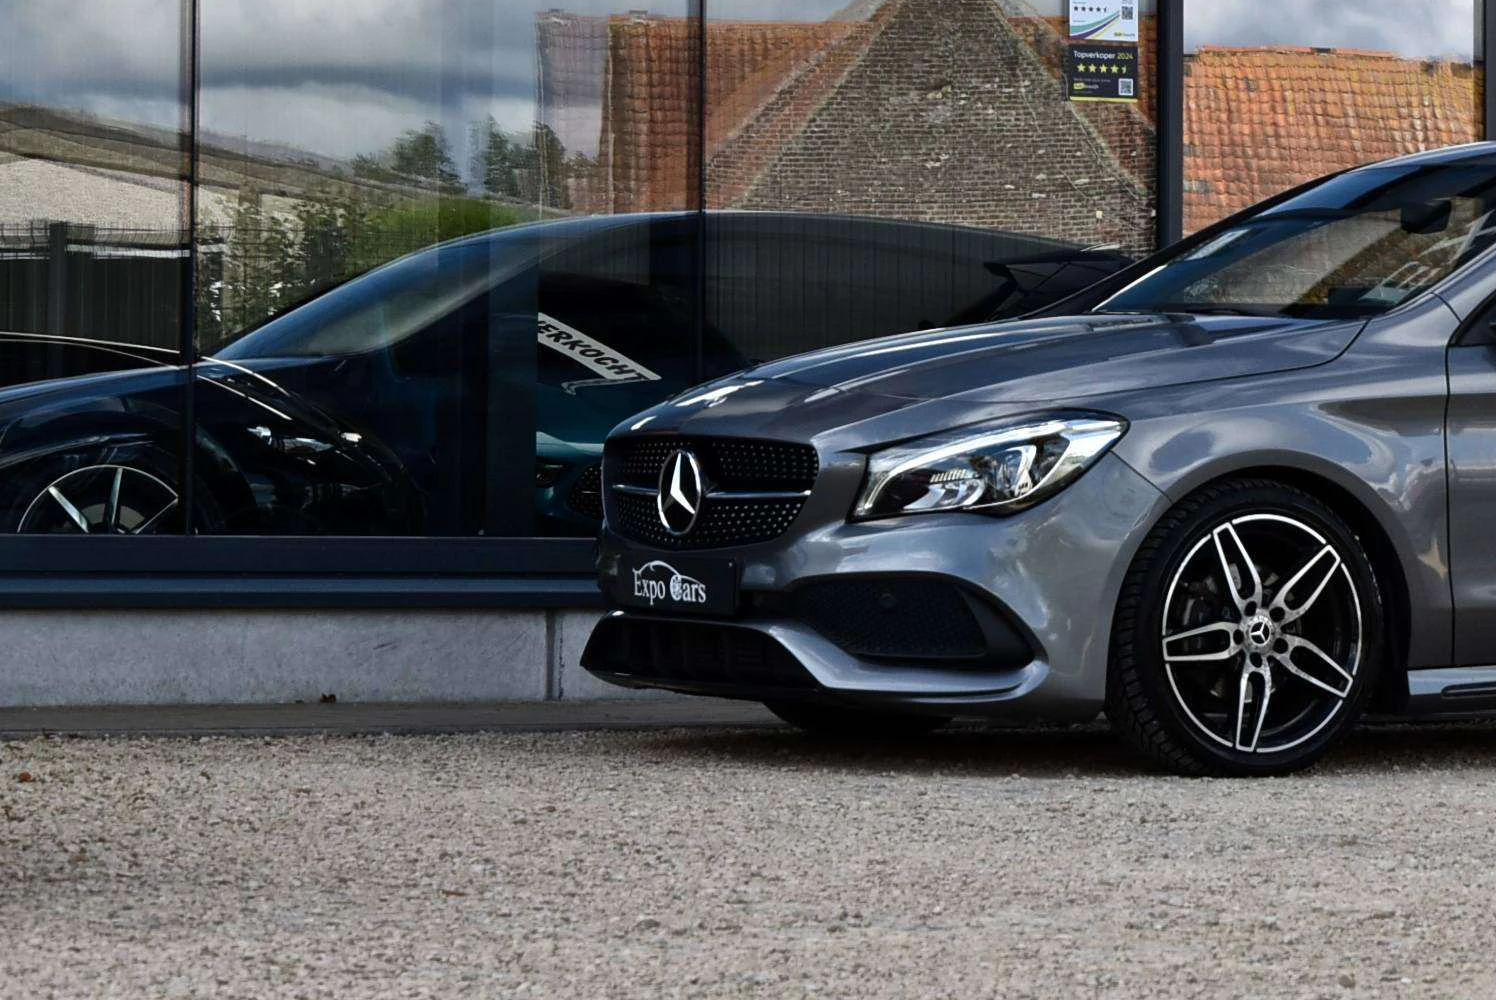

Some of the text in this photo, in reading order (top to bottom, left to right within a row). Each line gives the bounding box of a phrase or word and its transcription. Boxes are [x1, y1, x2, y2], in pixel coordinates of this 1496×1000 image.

[1073, 50, 1134, 60] Topverkoper 2024
[633, 569, 707, 606] Expo Cars
